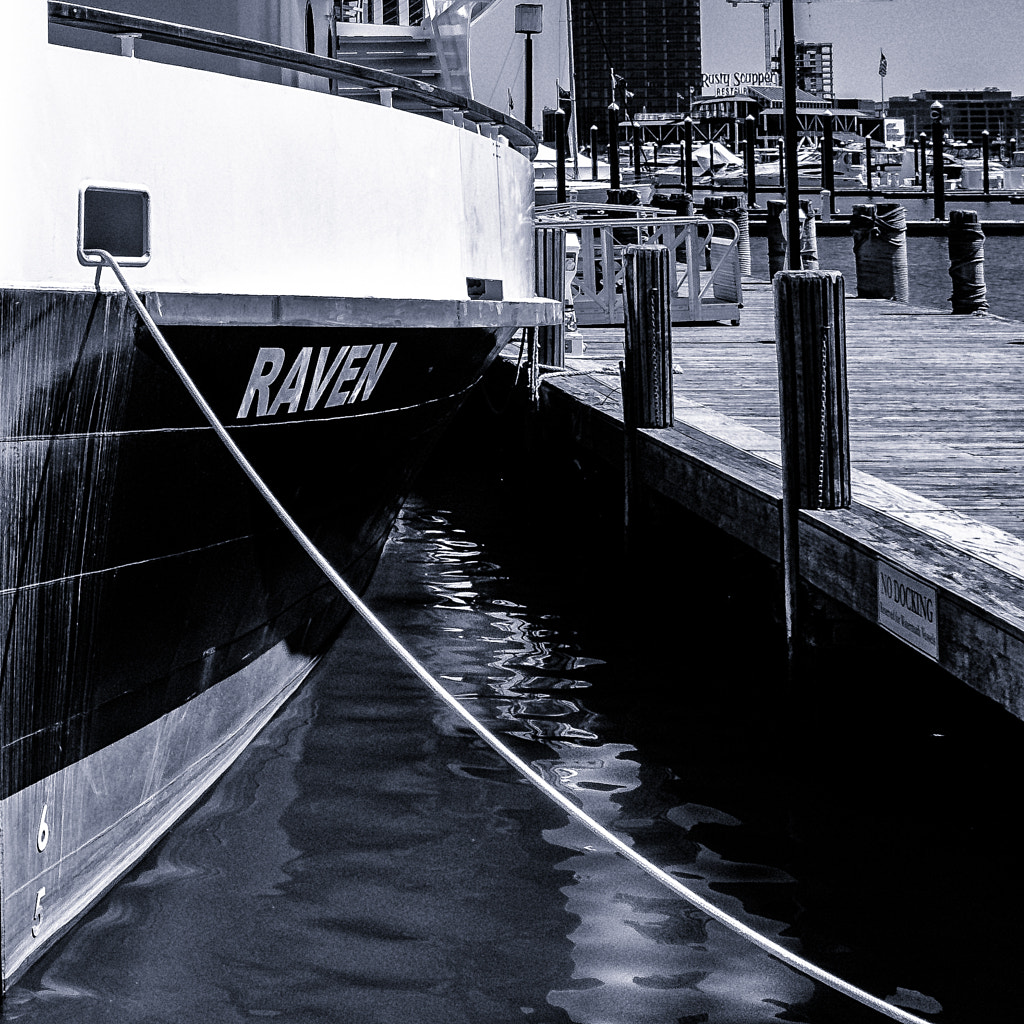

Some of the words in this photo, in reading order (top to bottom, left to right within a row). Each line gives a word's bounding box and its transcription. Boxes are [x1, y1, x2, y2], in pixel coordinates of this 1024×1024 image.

[701, 73, 730, 88] Rusty
[733, 72, 777, 87] Scupper
[236, 342, 398, 419] RAVEN
[880, 572, 893, 598] NO
[893, 579, 934, 623] DOCKING
[37, 804, 49, 853] 6
